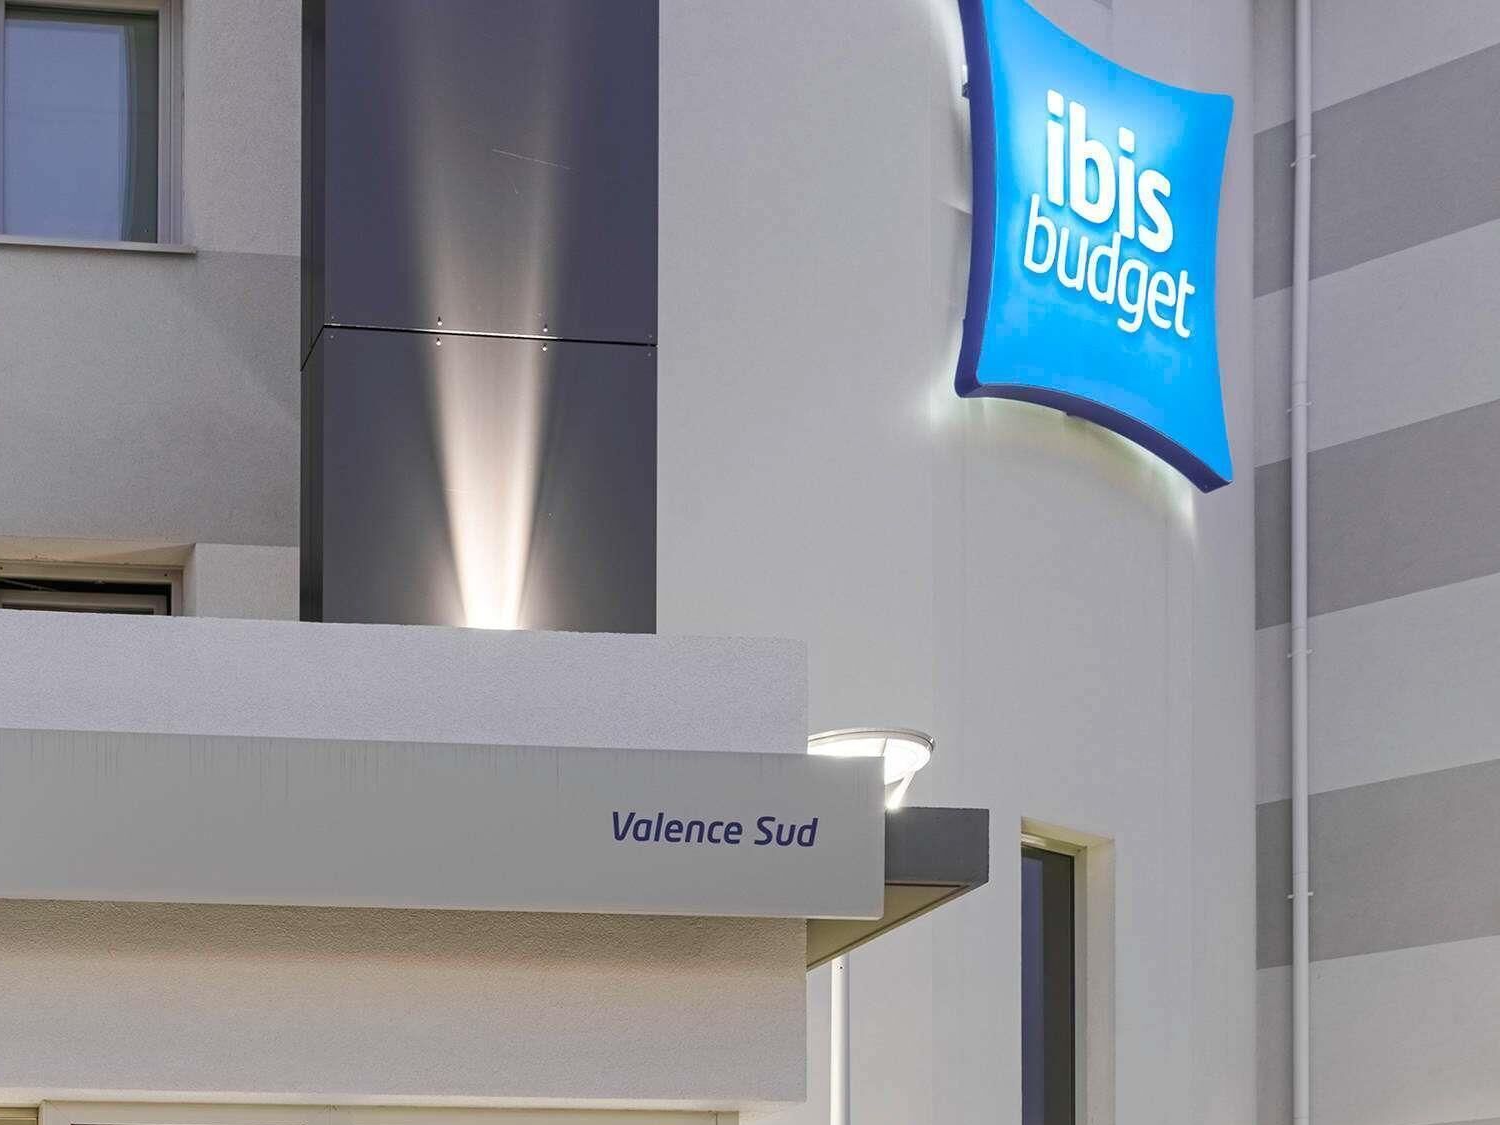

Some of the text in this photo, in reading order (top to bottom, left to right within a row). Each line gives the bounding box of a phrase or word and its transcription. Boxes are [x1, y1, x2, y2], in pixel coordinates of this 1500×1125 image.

[1046, 89, 1173, 254] ibis
[1023, 193, 1197, 338] budget
[611, 811, 820, 848] Valence Sud
